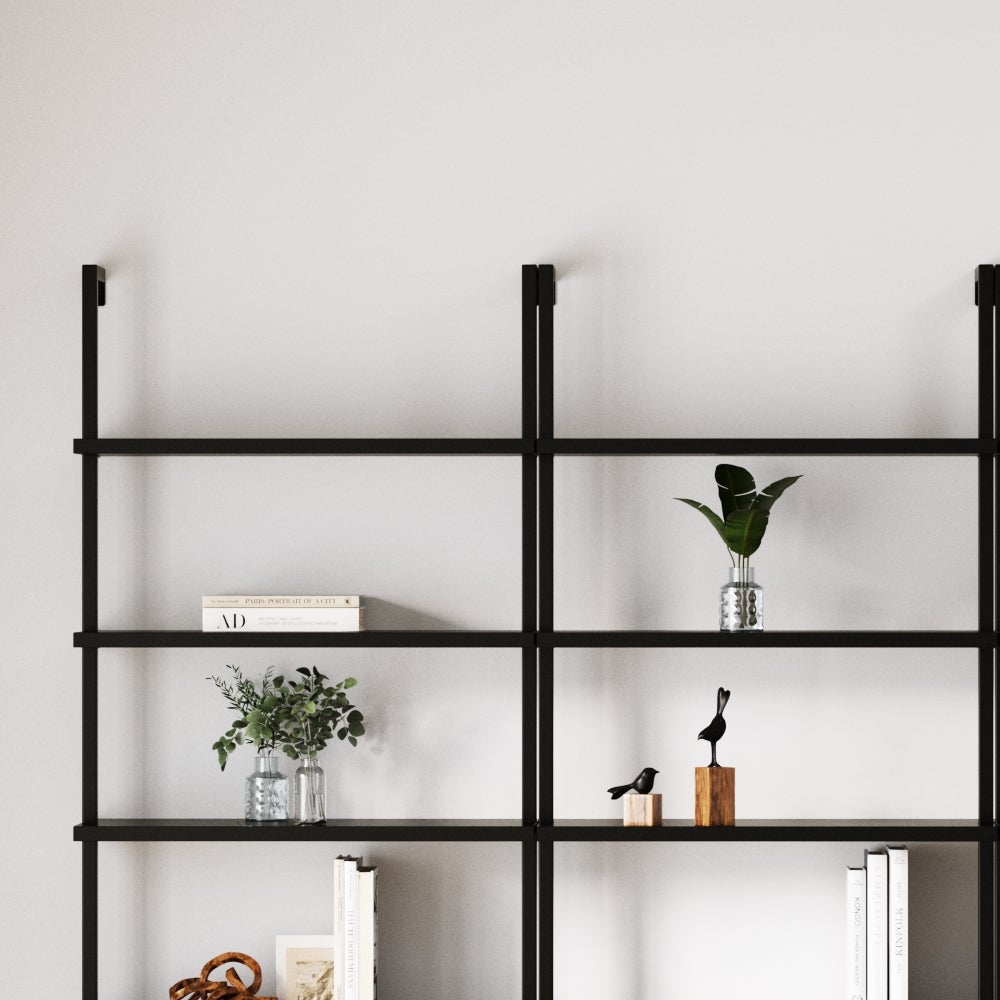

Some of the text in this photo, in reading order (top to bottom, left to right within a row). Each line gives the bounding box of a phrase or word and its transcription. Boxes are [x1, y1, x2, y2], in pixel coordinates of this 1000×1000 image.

[217, 613, 246, 629] AD
[854, 897, 862, 927] KONGO
[895, 907, 904, 957] KINFOLK
